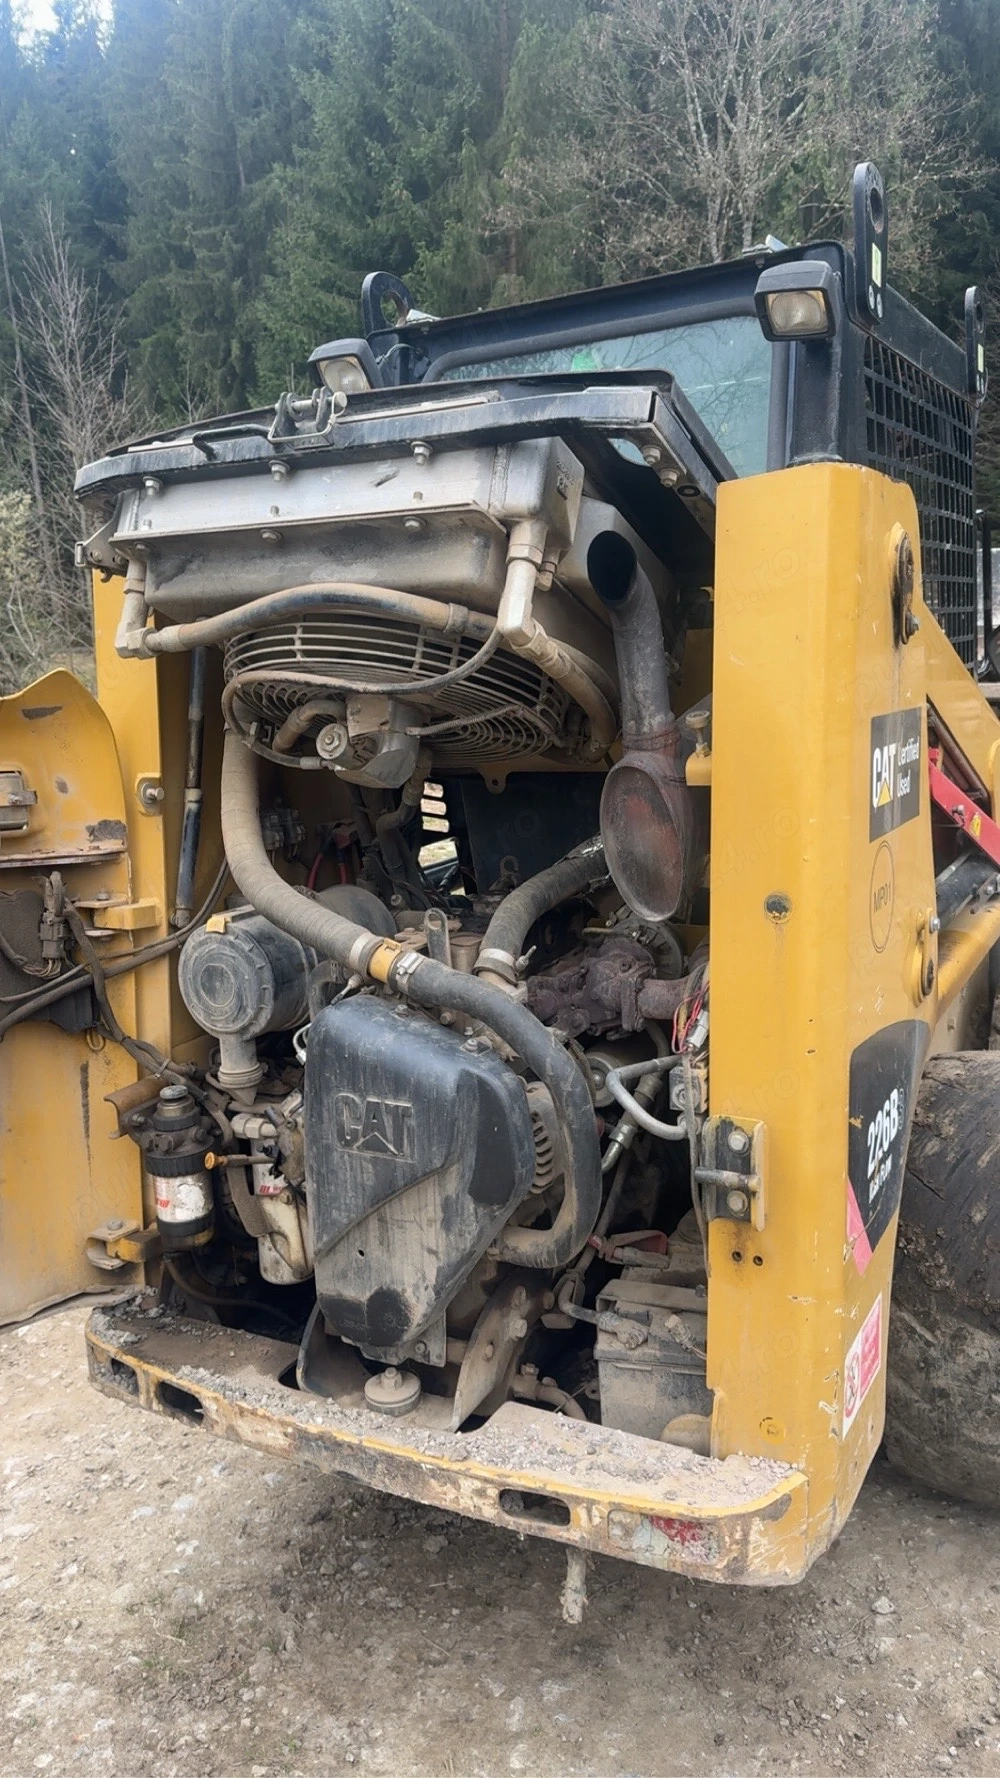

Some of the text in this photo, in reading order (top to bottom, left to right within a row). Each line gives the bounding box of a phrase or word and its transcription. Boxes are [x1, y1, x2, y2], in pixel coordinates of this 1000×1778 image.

[872, 742, 897, 810] CAT
[896, 769, 911, 797] Used
[873, 881, 892, 914] MP01
[334, 1092, 416, 1162] CAT
[867, 1088, 899, 1179] 226B
